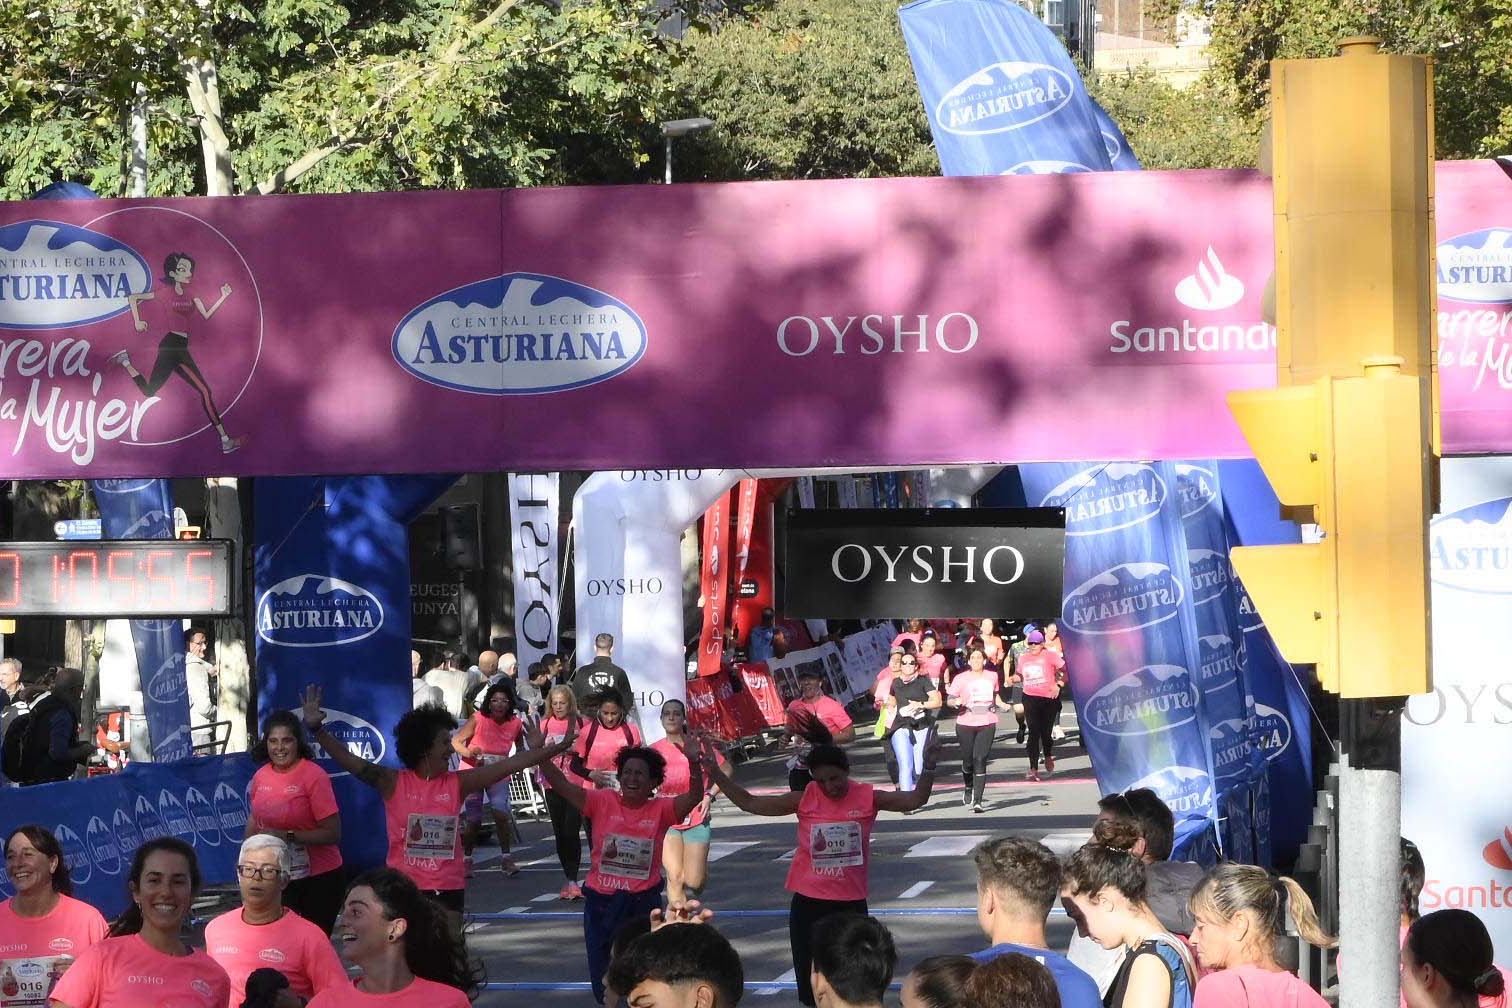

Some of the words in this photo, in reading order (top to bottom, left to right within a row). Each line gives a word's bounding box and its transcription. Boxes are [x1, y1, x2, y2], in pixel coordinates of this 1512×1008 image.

[55, 256, 127, 268] LECHERA
[451, 314, 529, 329] CENTRAL
[538, 313, 618, 327] LECHERA
[776, 312, 979, 356] OYSHO
[411, 320, 628, 365] ASTURIANA
[11, 373, 163, 466] Mujer
[831, 543, 1026, 585] OYSHO
[409, 583, 459, 597] EUGES
[587, 576, 663, 597] OYSHO
[412, 602, 459, 615] UNYA
[262, 603, 375, 631] ASTURIANA
[597, 875, 632, 891] SUMA
[20, 981, 43, 991] 016
[127, 975, 165, 985] OYSHO
